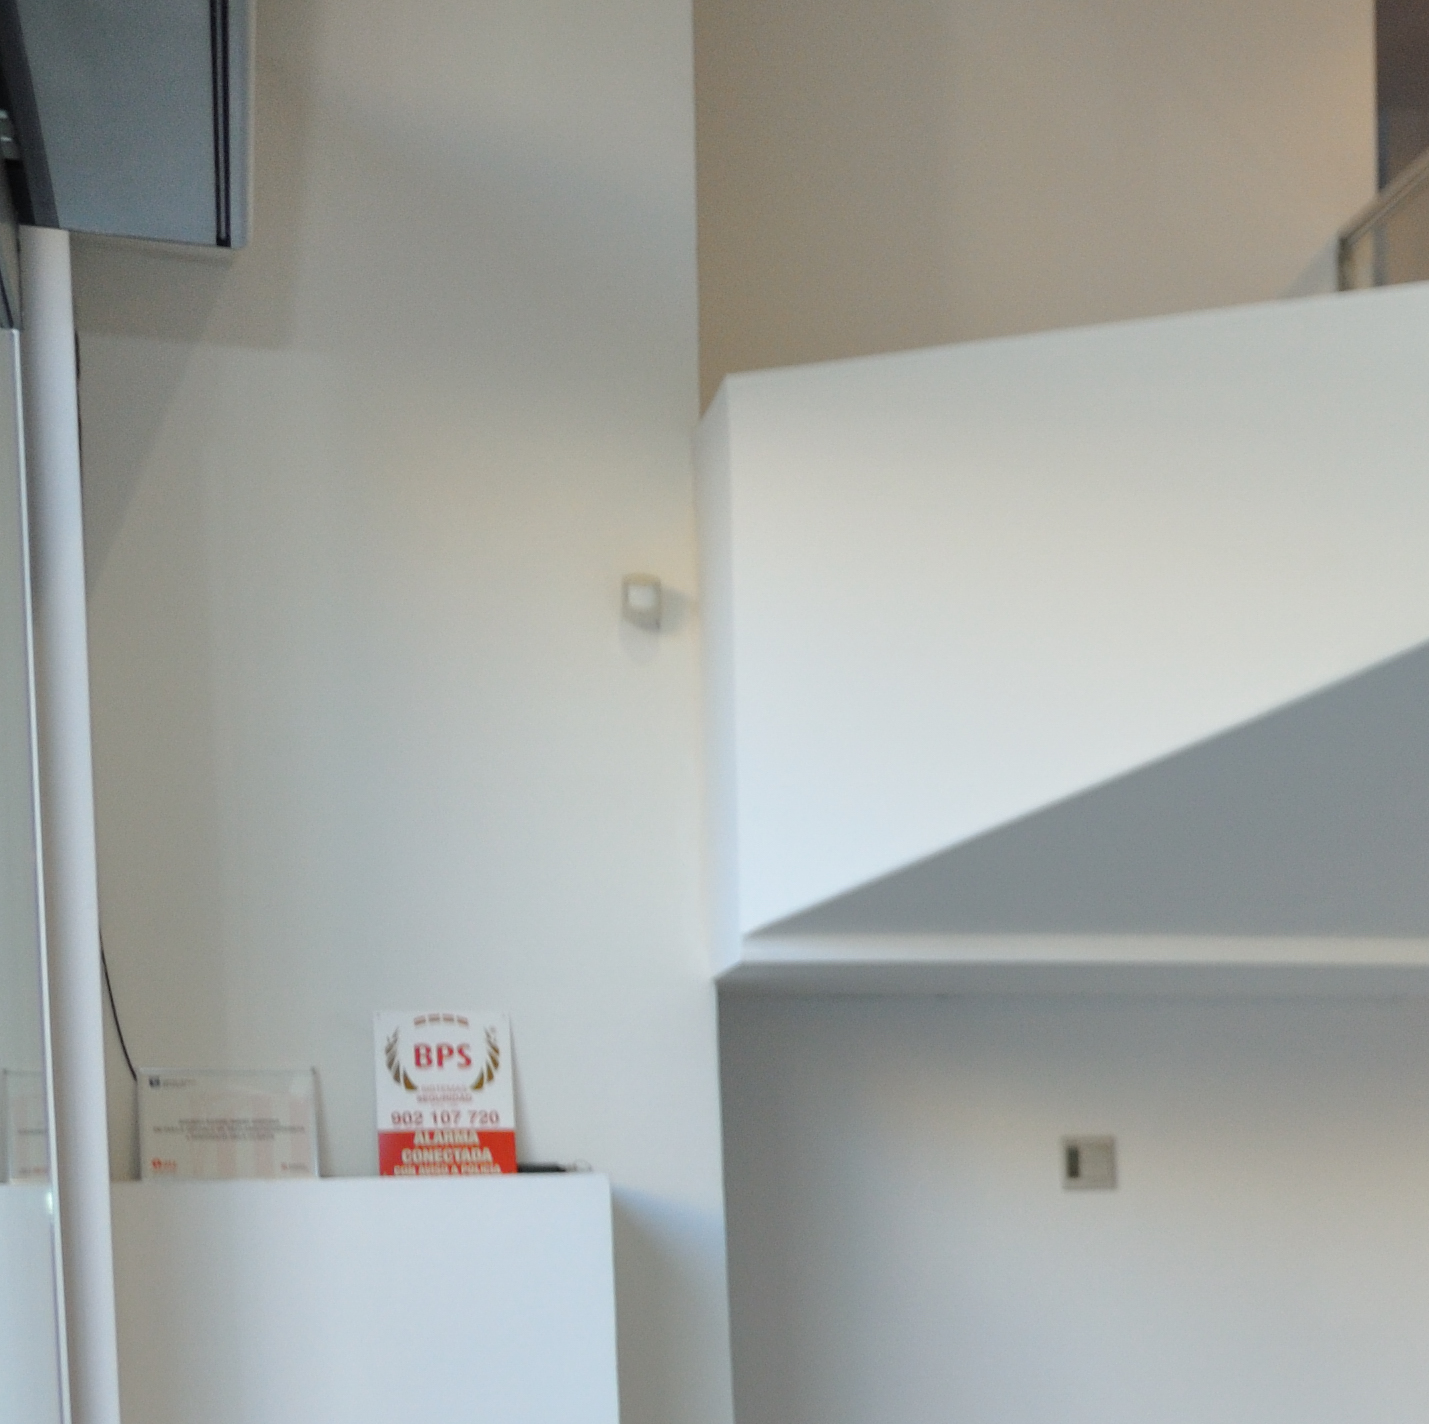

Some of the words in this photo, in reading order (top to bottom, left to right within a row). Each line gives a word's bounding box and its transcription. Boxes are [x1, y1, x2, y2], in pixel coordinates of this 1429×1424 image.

[414, 1043, 472, 1069] BPS
[391, 1110, 423, 1124] 902
[432, 1110, 461, 1124] 107
[469, 1110, 499, 1124] 720
[414, 1129, 479, 1145] ALARMA
[402, 1147, 493, 1163] CONECTADA
